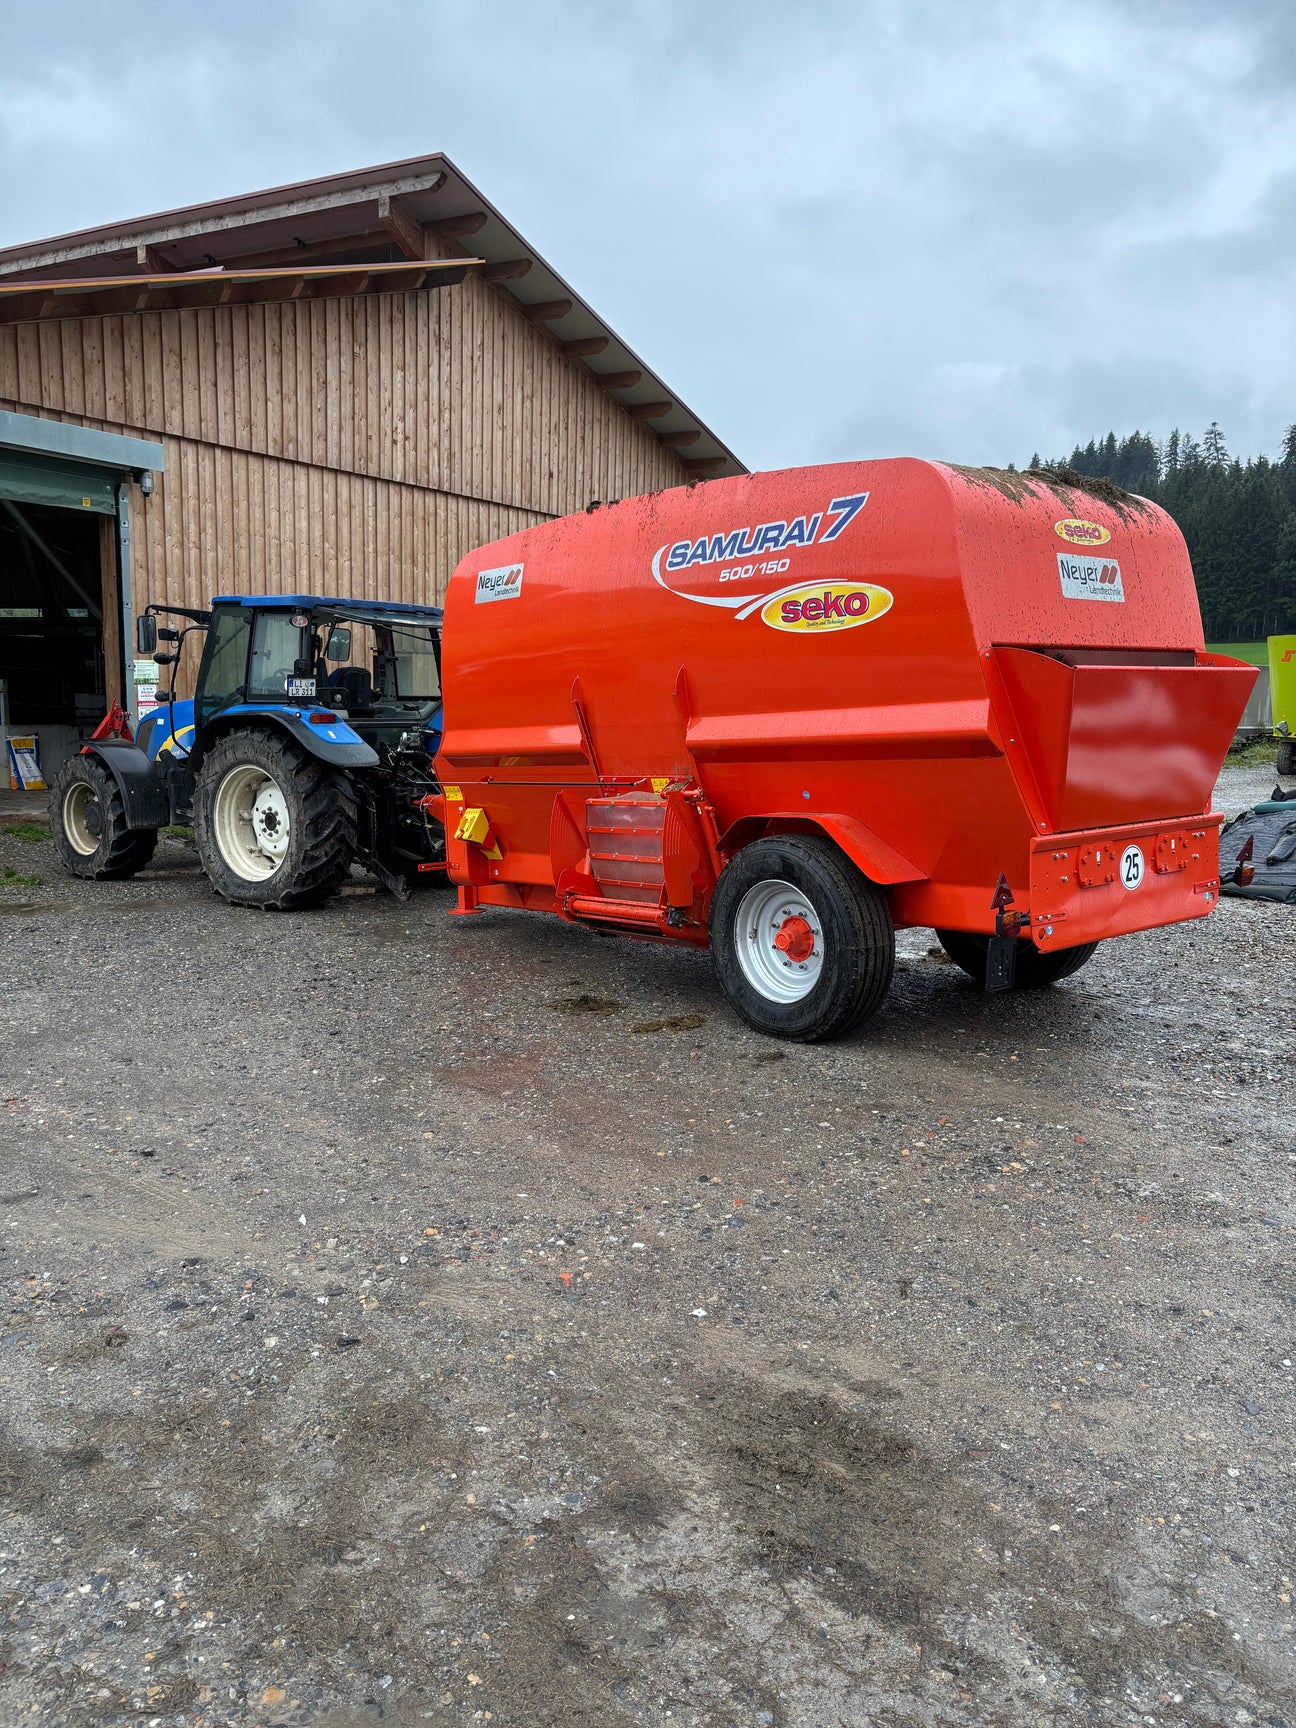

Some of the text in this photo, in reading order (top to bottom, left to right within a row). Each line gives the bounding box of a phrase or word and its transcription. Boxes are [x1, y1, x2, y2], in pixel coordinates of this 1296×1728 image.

[666, 491, 870, 571] SAMURAI 7
[1064, 524, 1102, 540] seko
[478, 574, 505, 591] Neyer
[719, 559, 790, 582] 500/150
[1060, 560, 1098, 585] Neyer
[781, 592, 869, 624] seko
[301, 688, 313, 696] 311
[1125, 852, 1140, 882] 25
